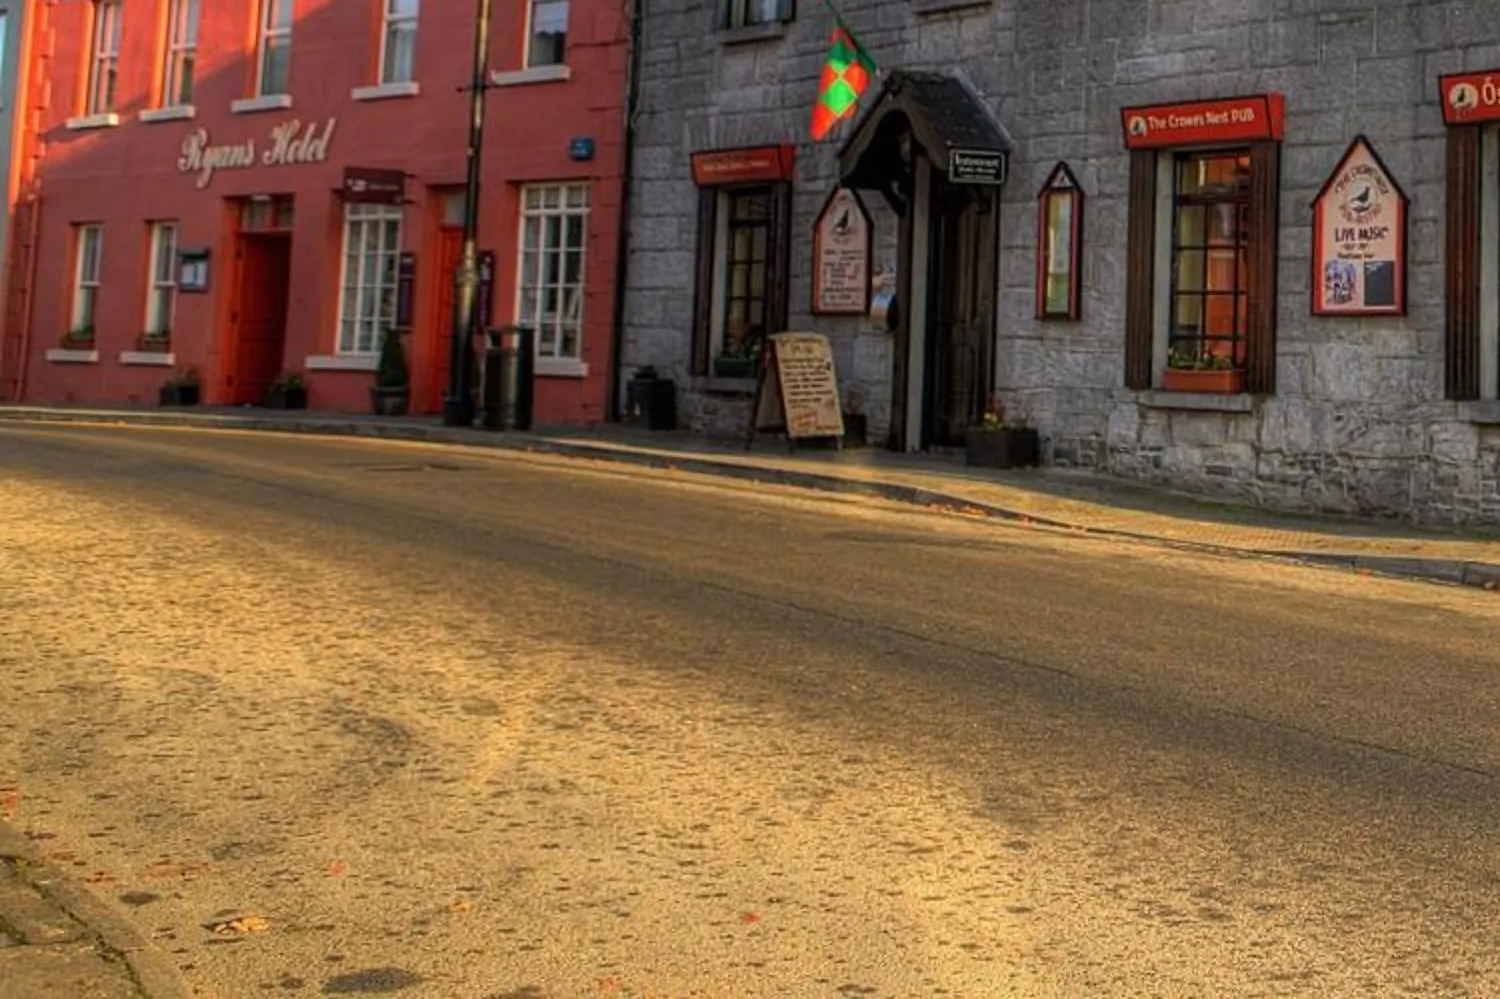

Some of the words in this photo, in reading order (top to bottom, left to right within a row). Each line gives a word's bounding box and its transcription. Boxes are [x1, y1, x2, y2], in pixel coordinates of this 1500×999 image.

[1149, 115, 1166, 130] The
[1206, 109, 1228, 125] Nest
[1231, 107, 1254, 122] PUB
[178, 127, 255, 189] Ryans
[263, 116, 337, 165] Hotel
